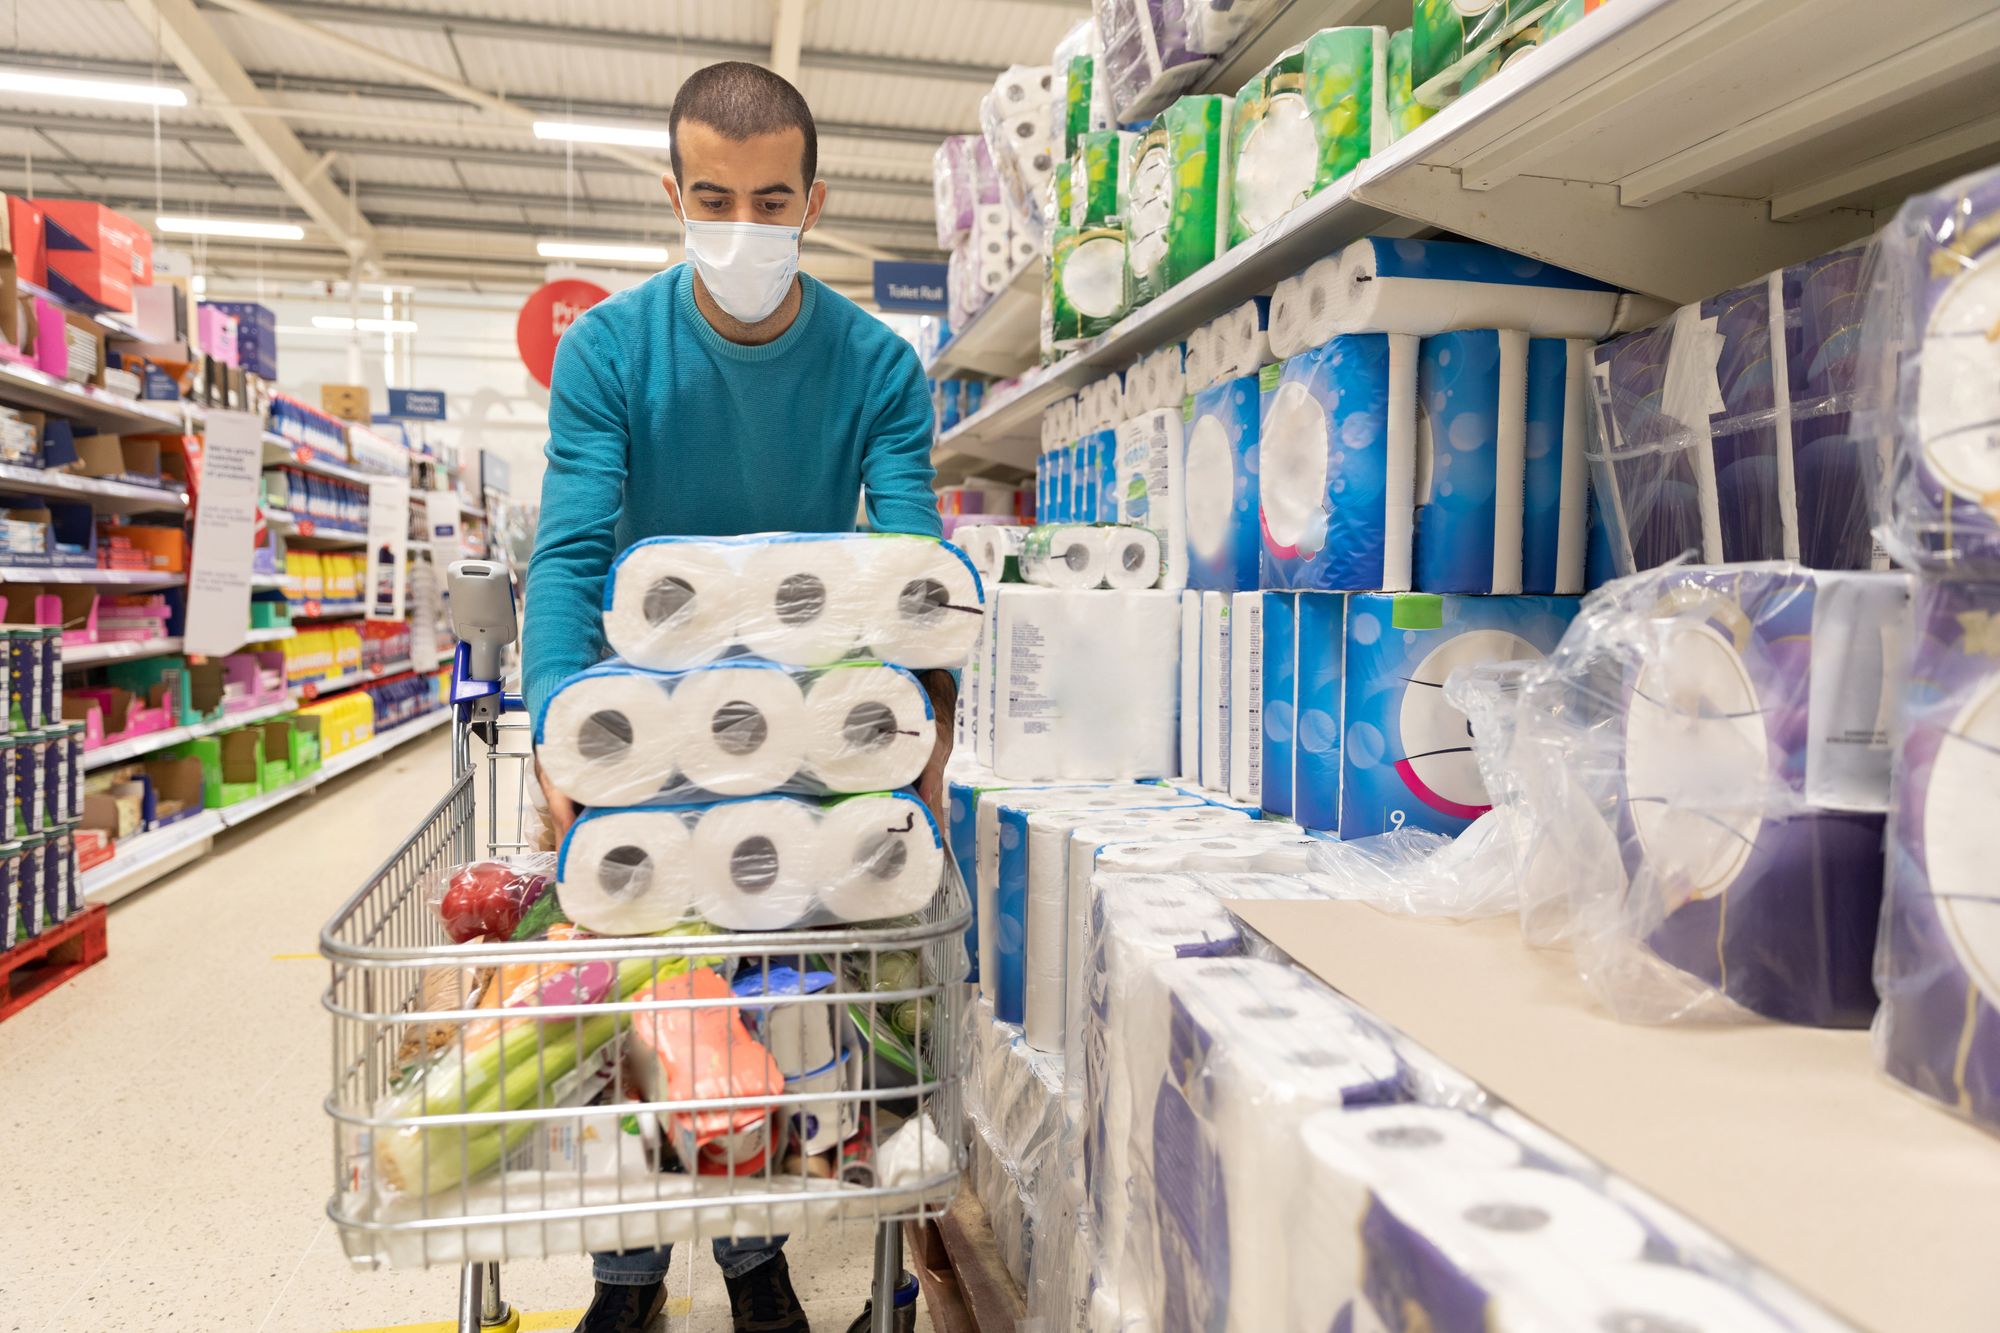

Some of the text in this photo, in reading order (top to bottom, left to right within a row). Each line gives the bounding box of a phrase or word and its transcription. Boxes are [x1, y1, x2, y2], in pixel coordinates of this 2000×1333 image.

[887, 283, 943, 301] Toilet Roll
[1390, 809, 1405, 831] 9
